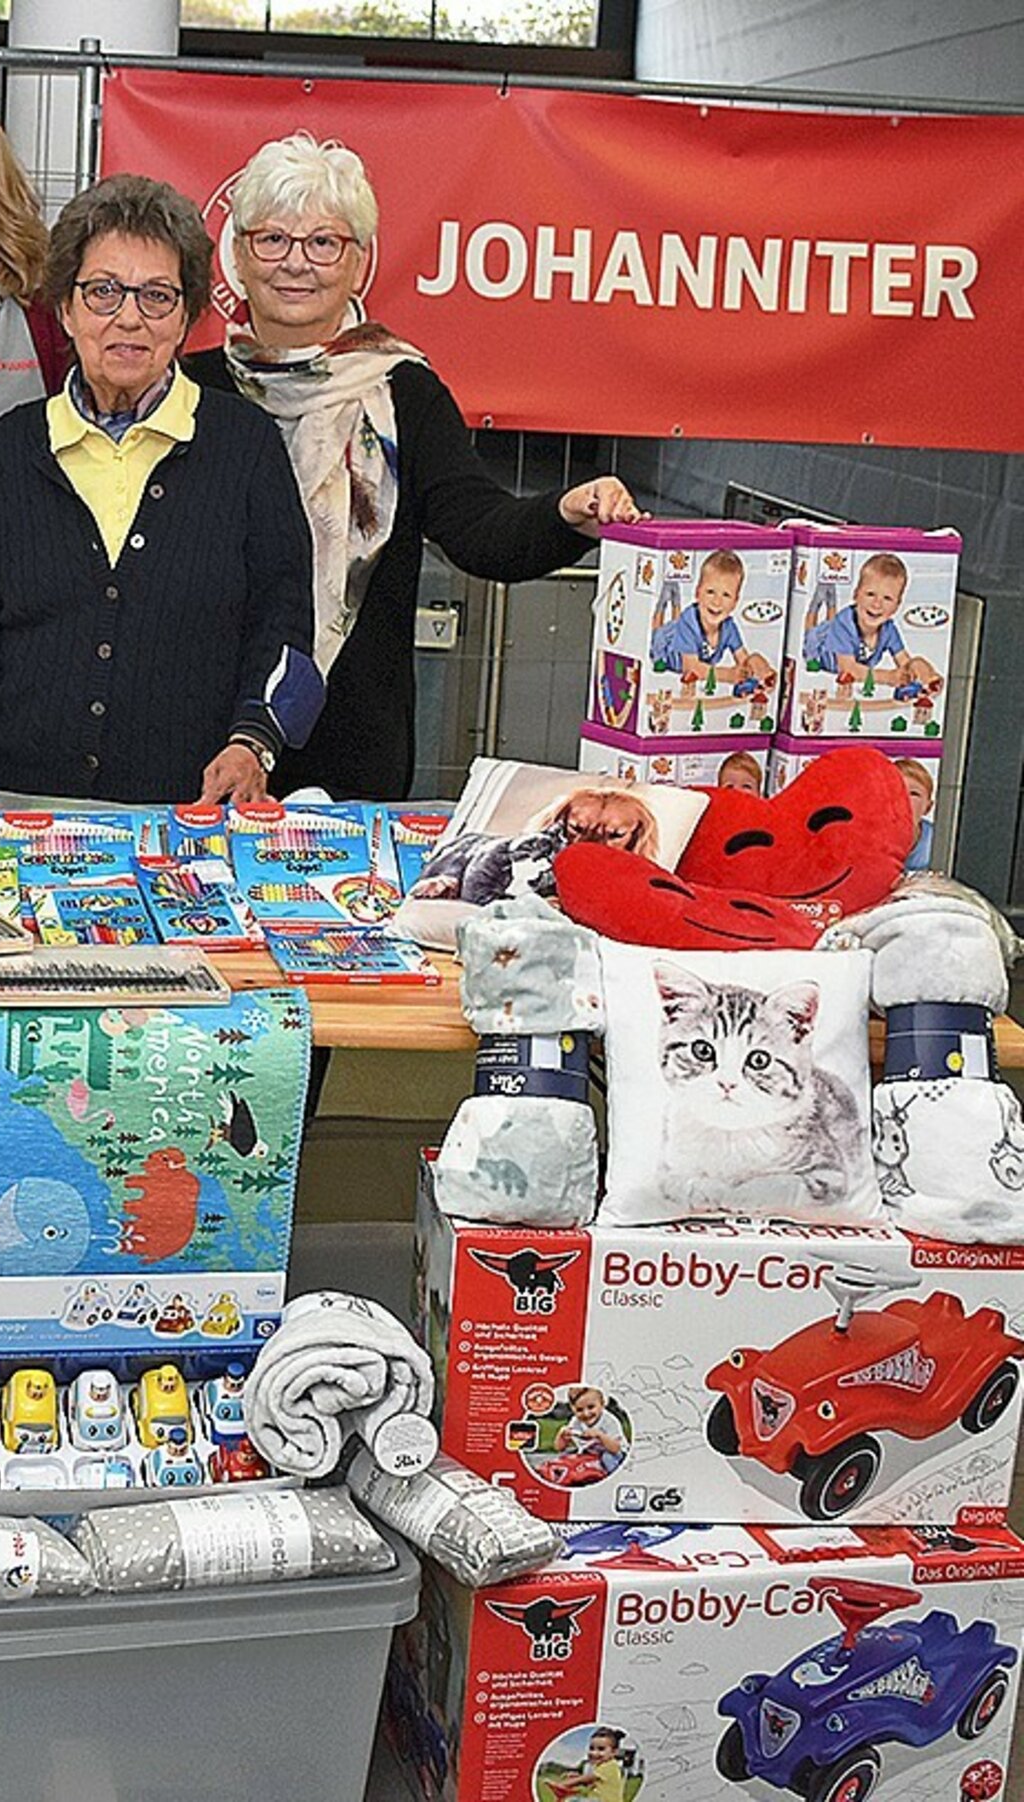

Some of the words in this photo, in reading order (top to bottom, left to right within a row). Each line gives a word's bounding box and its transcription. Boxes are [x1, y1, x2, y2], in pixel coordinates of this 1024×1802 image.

[416, 220, 980, 320] JOHANNITER
[144, 1009, 184, 1144] America
[175, 1024, 212, 1124] North
[915, 1249, 943, 1265] Das
[603, 1251, 834, 1296] Bobby-Car
[515, 1295, 554, 1312] BIG
[600, 1289, 664, 1308] Classic
[649, 1487, 683, 1513] GS
[916, 1566, 943, 1581] Das
[616, 1583, 837, 1629] Bobby-Car
[613, 1629, 675, 1647] Classic
[533, 1642, 569, 1659] BIG
